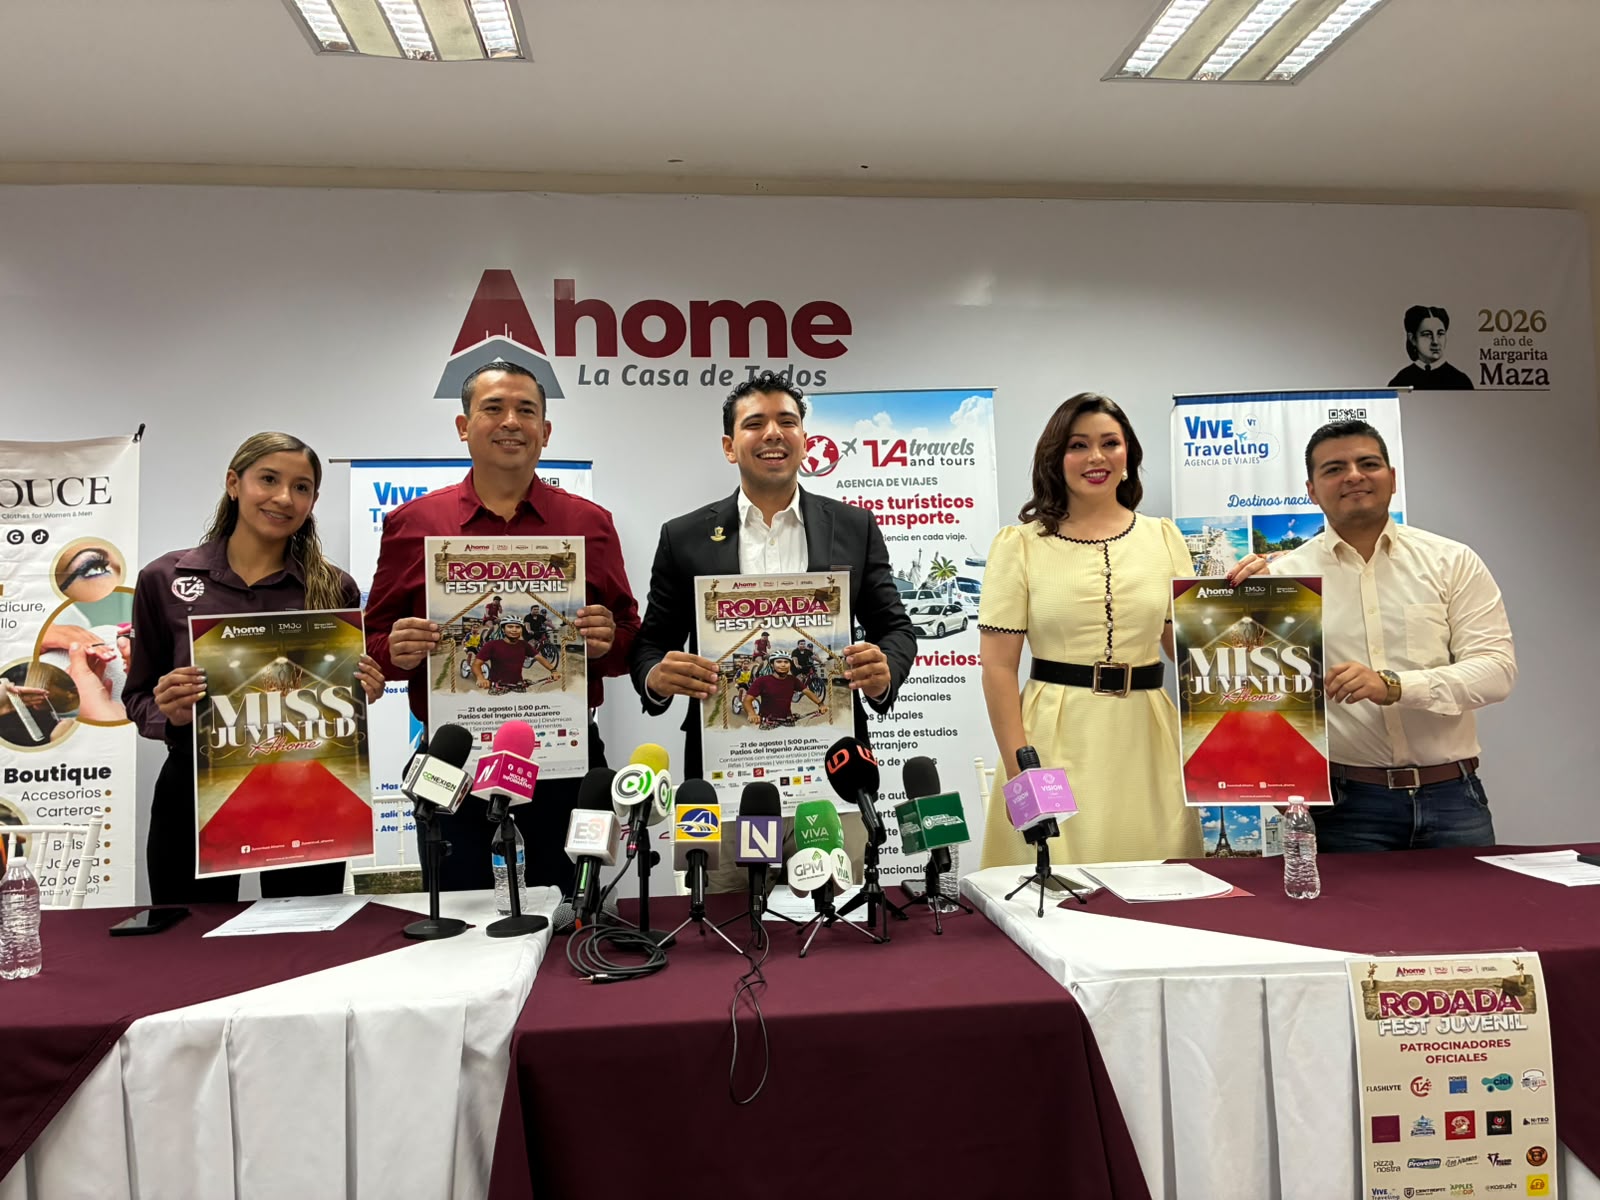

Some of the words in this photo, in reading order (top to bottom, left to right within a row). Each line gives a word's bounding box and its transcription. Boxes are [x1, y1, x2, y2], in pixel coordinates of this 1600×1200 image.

[1478, 309, 1548, 333] 2026
[434, 269, 852, 398] Ahome
[1493, 336, 1516, 347] año
[1518, 336, 1534, 347] de
[1480, 348, 1548, 364] Margarita
[578, 364, 610, 386] La
[622, 364, 690, 386] Casa
[700, 364, 734, 387] de
[1480, 363, 1550, 386] Maza
[910, 438, 974, 456] travels
[1184, 439, 1269, 459] Traveling
[910, 456, 935, 467] and
[940, 457, 976, 467] tours
[1184, 458, 1220, 467] AGENCIA
[1234, 456, 1260, 465] VIAJES
[836, 478, 884, 489] AGENCIA
[886, 478, 900, 488] DE
[901, 477, 938, 487] VIAJES
[888, 493, 974, 510] turísticos
[1227, 494, 1282, 508] Destinos
[875, 511, 960, 530] ansporte.
[945, 533, 968, 542] viaje.
[448, 562, 566, 582] RODADA
[445, 580, 488, 594] FEST
[492, 580, 568, 594] JUVENIL
[1196, 587, 1235, 599] Ahome
[716, 597, 831, 618] RODADA
[716, 618, 756, 632] FEST
[760, 614, 832, 630] JUVENIL
[221, 625, 266, 639] Ahome
[916, 650, 982, 666] rvicios:
[1188, 646, 1312, 682] MISS
[904, 674, 966, 685] sonalizados
[1190, 674, 1314, 696] JUVENTUD
[210, 686, 355, 734] MISS
[487, 706, 513, 714] agosto
[494, 712, 522, 720] Ingenio
[877, 710, 924, 723] grupales
[210, 716, 356, 749] JUVENTUD
[897, 728, 911, 738] de
[913, 727, 958, 737] estudios
[766, 746, 792, 754] Ingenio
[870, 740, 918, 752] xtranjero
[887, 758, 900, 766] de
[4, 763, 112, 786] Boutique
[21, 788, 102, 802] Accesorios
[36, 806, 101, 818] Carteras
[801, 827, 830, 840] VIVA
[794, 860, 824, 876] GPM
[1396, 967, 1426, 978] Ahome
[1379, 989, 1524, 1018] RODADA
[1378, 1018, 1430, 1036] FEST
[1436, 1014, 1528, 1034] JUVENIL
[1400, 1038, 1511, 1052] PATROCINADORES
[1426, 1052, 1488, 1064] OFICIALES
[1366, 1084, 1402, 1093] FLASHLYTE
[1374, 1160, 1394, 1168] pizza
